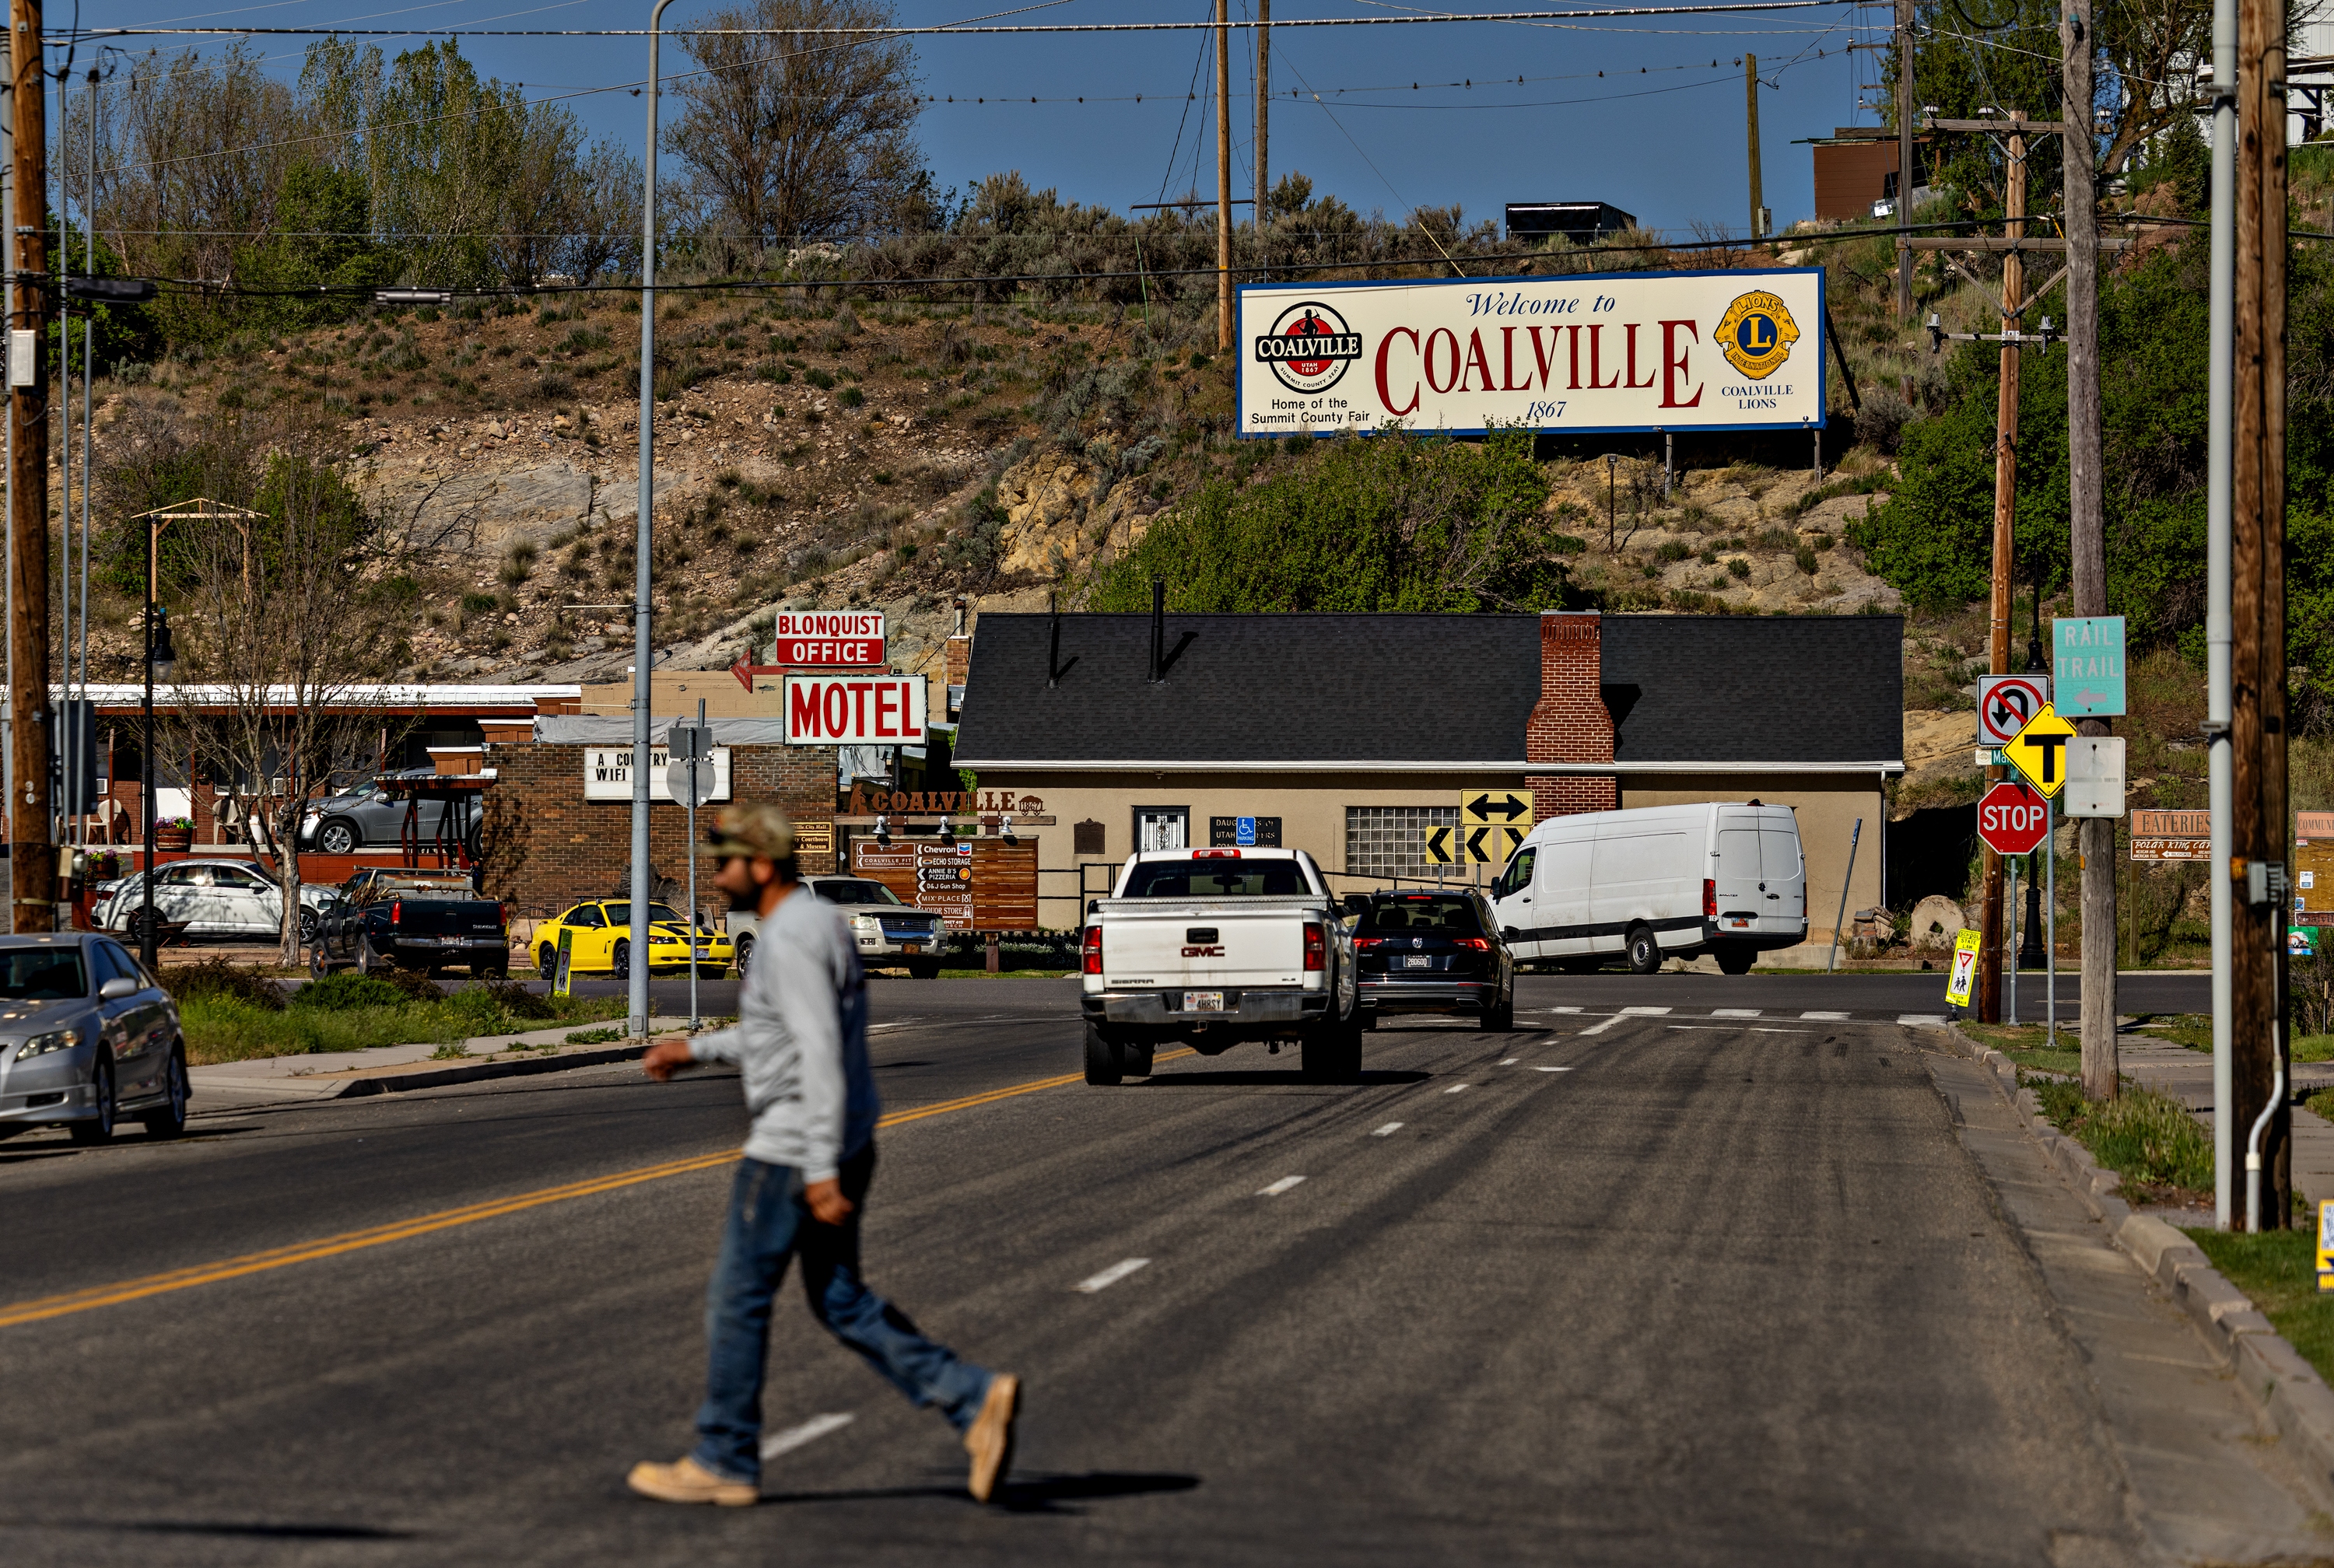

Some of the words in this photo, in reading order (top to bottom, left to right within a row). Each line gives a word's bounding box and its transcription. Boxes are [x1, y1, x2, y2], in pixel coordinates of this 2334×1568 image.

[1466, 292, 1579, 317] Welcome
[1593, 294, 1616, 313] to
[1736, 295, 1779, 314] LIONS
[1747, 317, 1772, 348] L
[1258, 337, 1358, 358] COALVILLE
[1375, 320, 1704, 416] COALVILLE
[1730, 351, 1785, 370] INTERNATIONAL
[1280, 367, 1301, 386] SUMMIT
[1302, 378, 1326, 387] COUNTY
[1328, 365, 1340, 380] SEAT
[1722, 385, 1794, 397] COALVILLE
[1272, 398, 1305, 410] Home
[1311, 397, 1323, 408] of
[1329, 397, 1347, 408] the
[1527, 401, 1567, 419] 1867
[1739, 398, 1777, 409] LIONS
[1252, 413, 1295, 424] Summit
[1301, 412, 1343, 424] County
[1348, 411, 1370, 422] Fair
[779, 615, 882, 637] BLONQUIST
[2066, 625, 2114, 647] RAIL
[792, 642, 869, 662] OFFICE
[2059, 656, 2120, 678] TRAIL
[791, 682, 921, 738] MOTEL
[598, 753, 605, 766] A
[616, 753, 668, 766] CORY
[1993, 751, 2010, 763] Ma
[596, 768, 626, 781] WIFI
[871, 792, 1015, 810] COALVILLE
[1022, 802, 1040, 810] 1867
[1983, 806, 2045, 831] STOP
[2142, 814, 2211, 833] EATERIES
[2168, 842, 2191, 851] KING
[1961, 931, 1979, 940] SCHOOL
[1181, 946, 1225, 957] GMC
[1197, 999, 1221, 1010] 4H8SY
